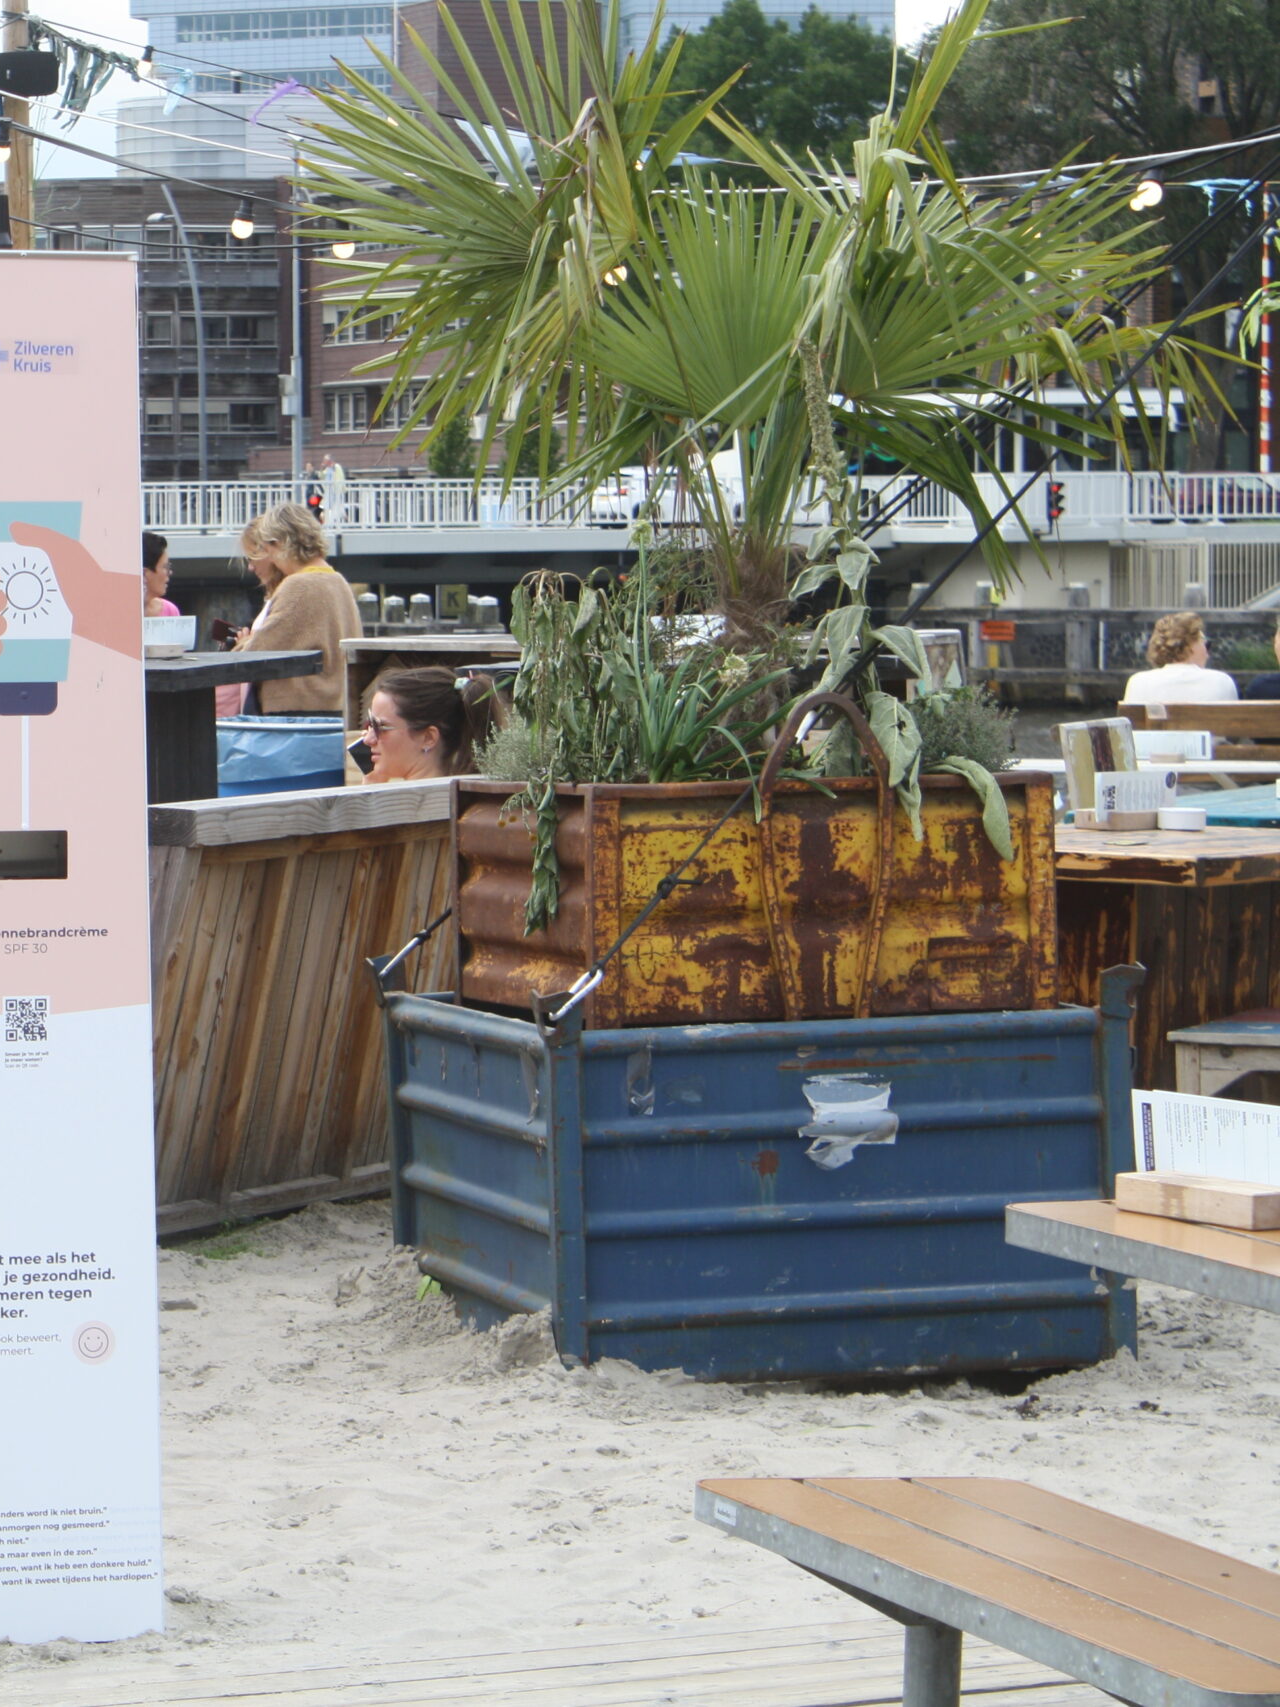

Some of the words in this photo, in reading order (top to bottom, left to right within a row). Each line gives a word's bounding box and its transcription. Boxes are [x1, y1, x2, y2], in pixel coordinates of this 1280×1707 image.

[14, 341, 74, 356] Zilveren
[14, 358, 52, 372] Kruis
[4, 944, 29, 954] SPF
[32, 943, 48, 954] 30
[9, 1255, 42, 1265] mee
[46, 1252, 67, 1264] als
[71, 1252, 96, 1263] het
[3, 1271, 18, 1286] je
[22, 1268, 116, 1284] gezondheid.
[48, 1288, 92, 1301] tegen
[16, 1333, 62, 1344] beweert,
[62, 1575, 91, 1584] tijdens
